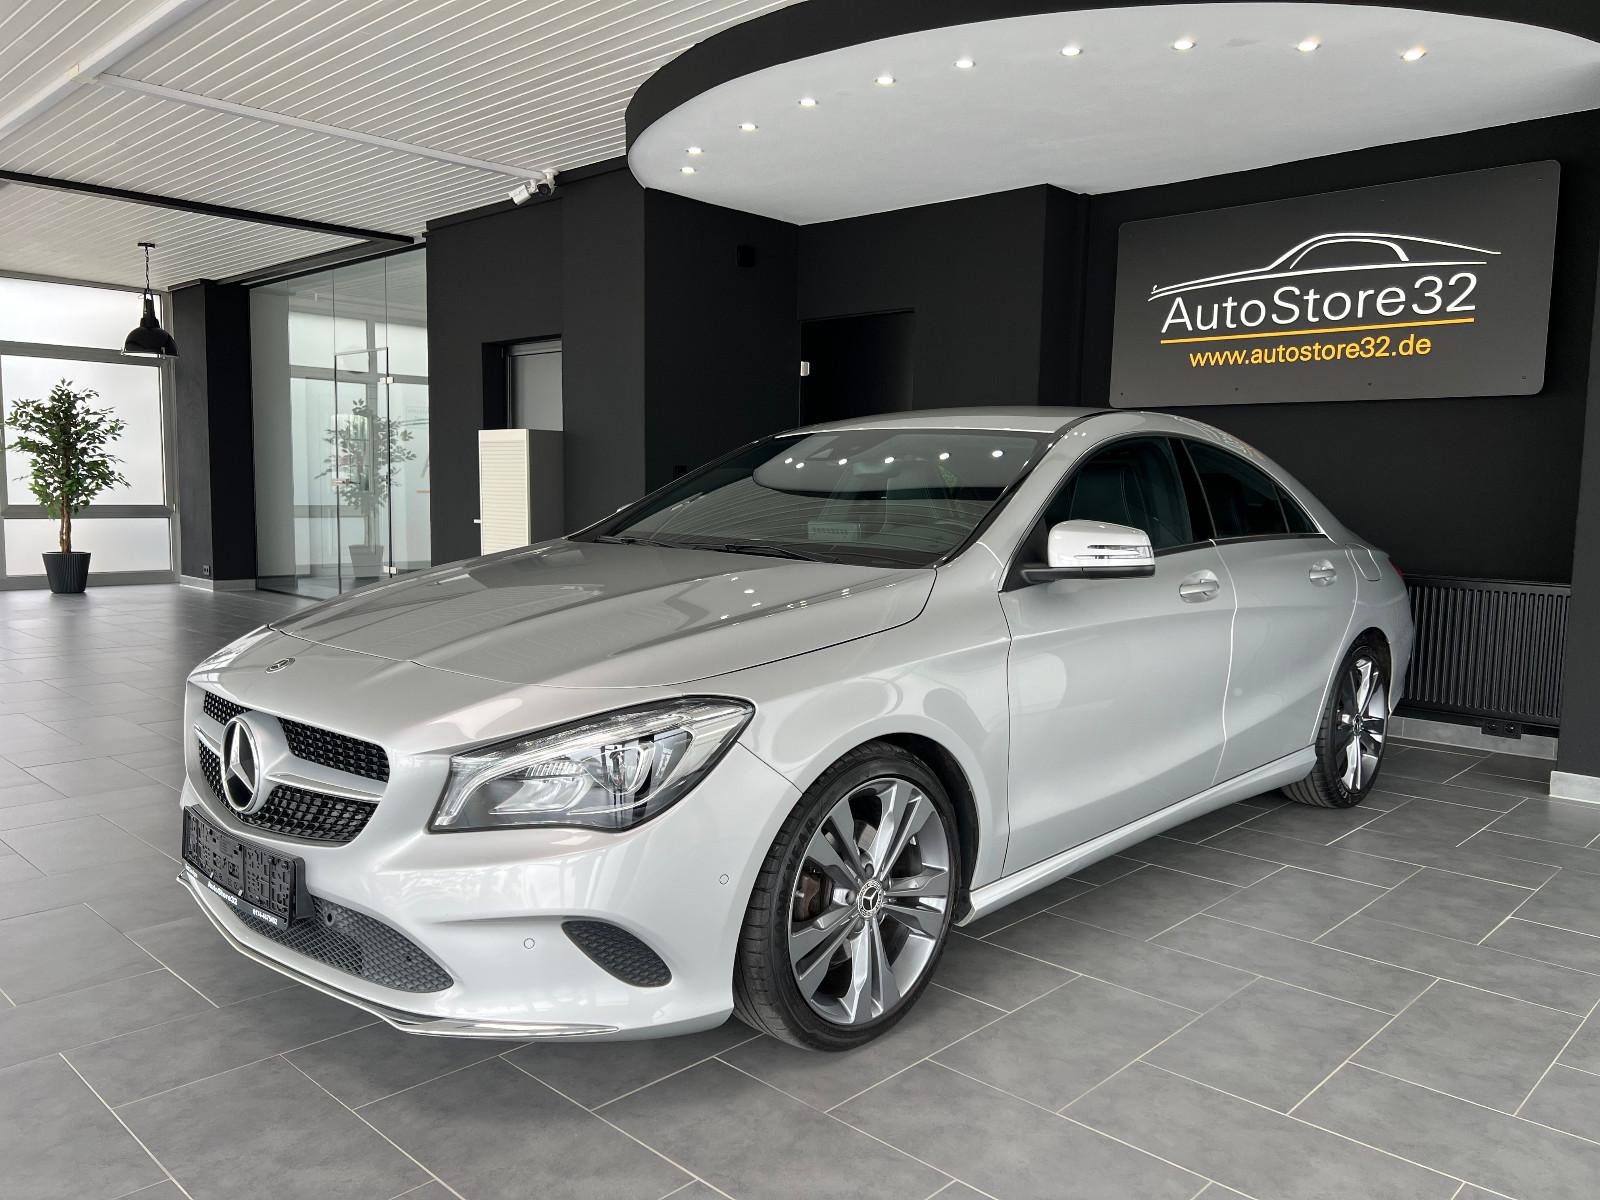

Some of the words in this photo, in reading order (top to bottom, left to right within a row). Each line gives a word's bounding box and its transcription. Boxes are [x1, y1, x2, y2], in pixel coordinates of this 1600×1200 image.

[1161, 272, 1477, 334] AutoStore32
[1188, 334, 1433, 368] www.autostore32.de
[207, 880, 238, 906] AutoStore32
